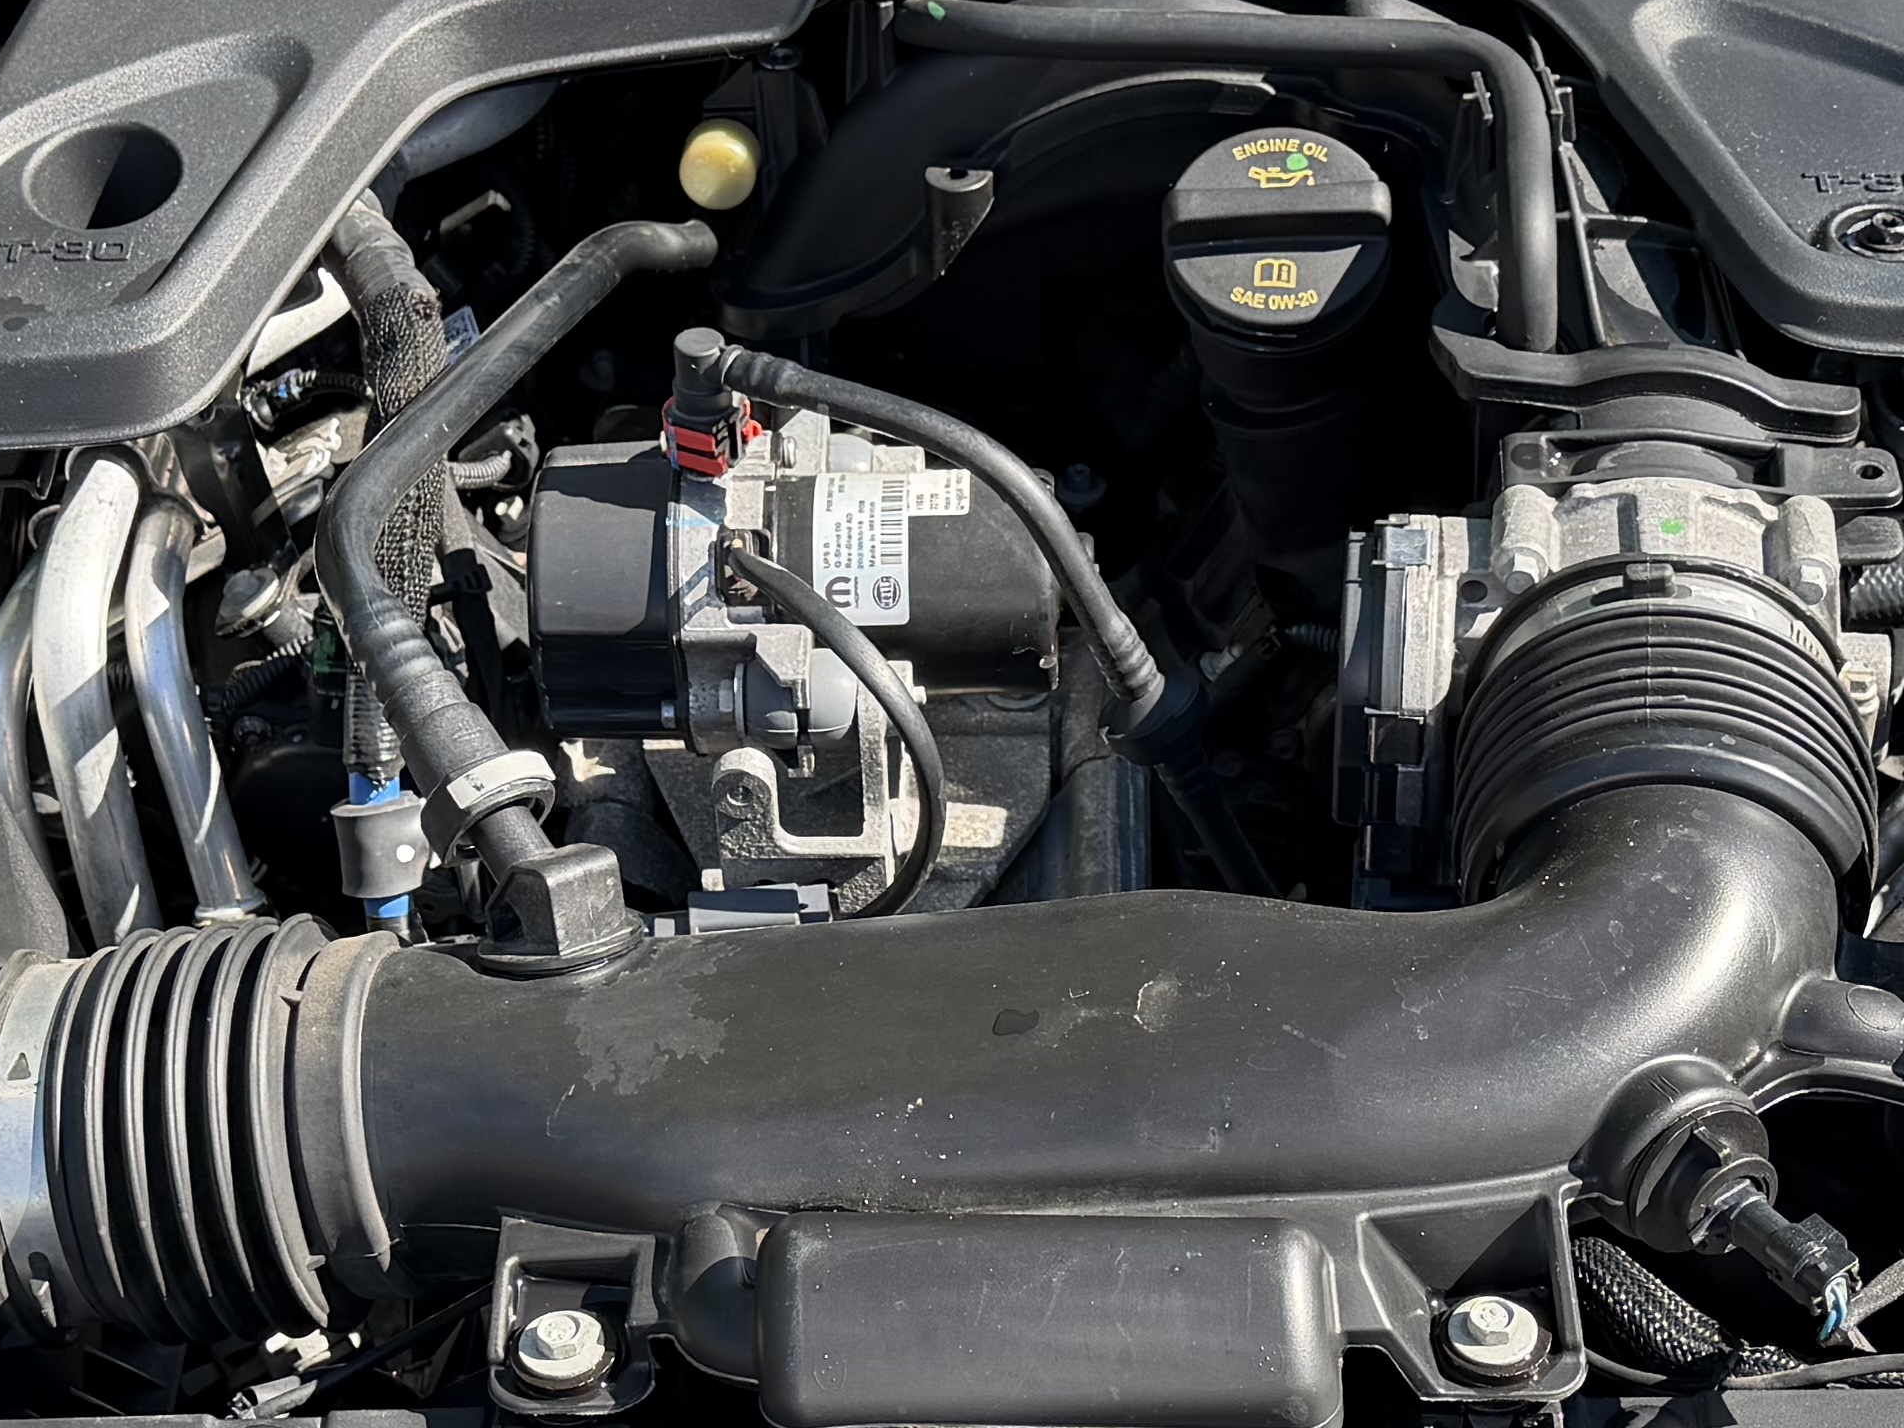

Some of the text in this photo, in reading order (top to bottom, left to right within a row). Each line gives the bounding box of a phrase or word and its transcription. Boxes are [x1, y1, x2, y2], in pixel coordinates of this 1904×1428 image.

[1232, 139, 1328, 163] ENGINE OIL
[1230, 286, 1319, 310] SAE 0W-20
